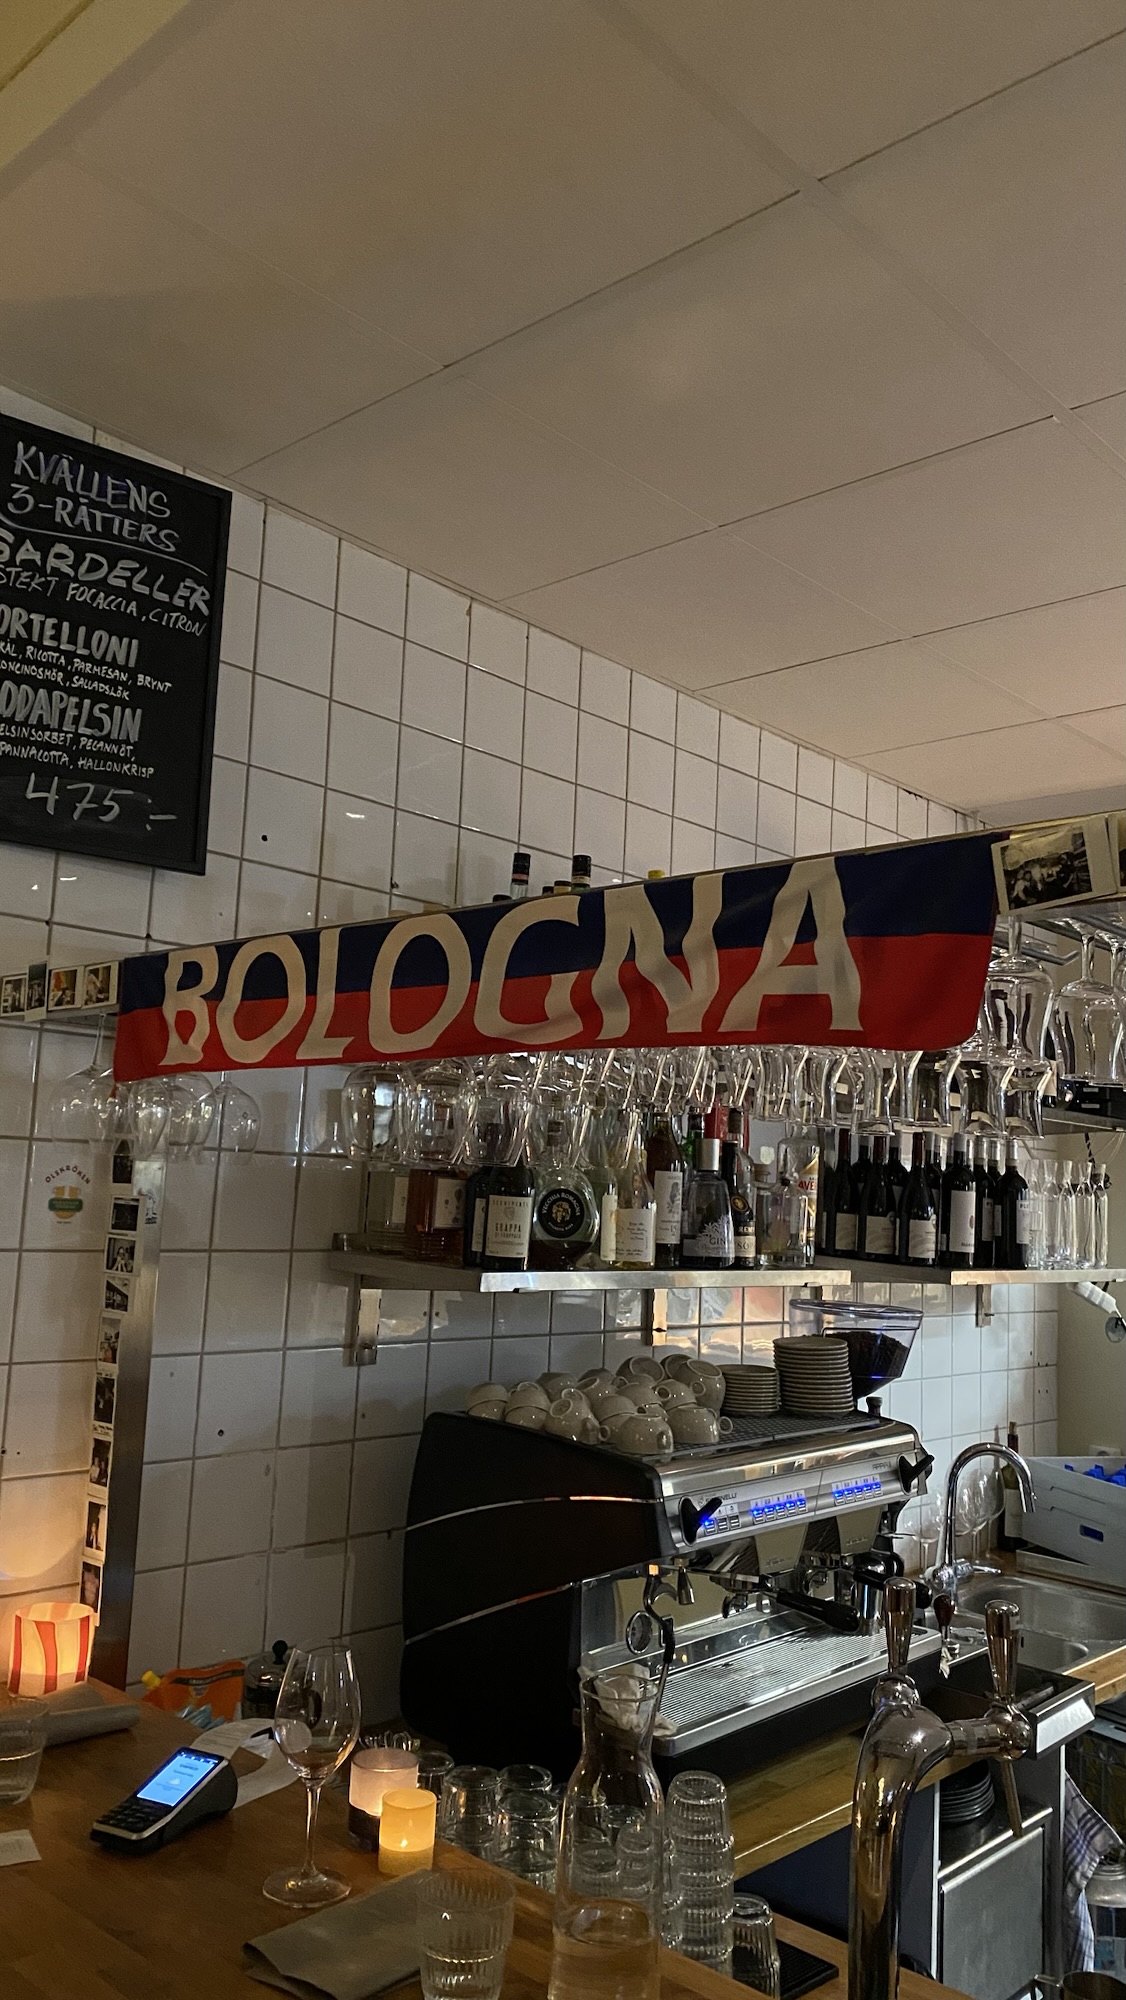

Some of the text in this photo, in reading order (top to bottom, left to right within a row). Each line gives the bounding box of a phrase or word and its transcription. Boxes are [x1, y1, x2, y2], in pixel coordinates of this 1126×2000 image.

[13, 441, 171, 518] KVÄLLENS
[7, 483, 180, 552] 3-RÄTTERS
[149, 608, 207, 637] CITRON
[71, 675, 130, 700] SALLADSLÖK
[137, 673, 173, 693] BRYNT
[78, 757, 154, 778] HALLONKRISP
[160, 856, 864, 1066] BOLOGNA
[709, 1237, 726, 1245] GIN
